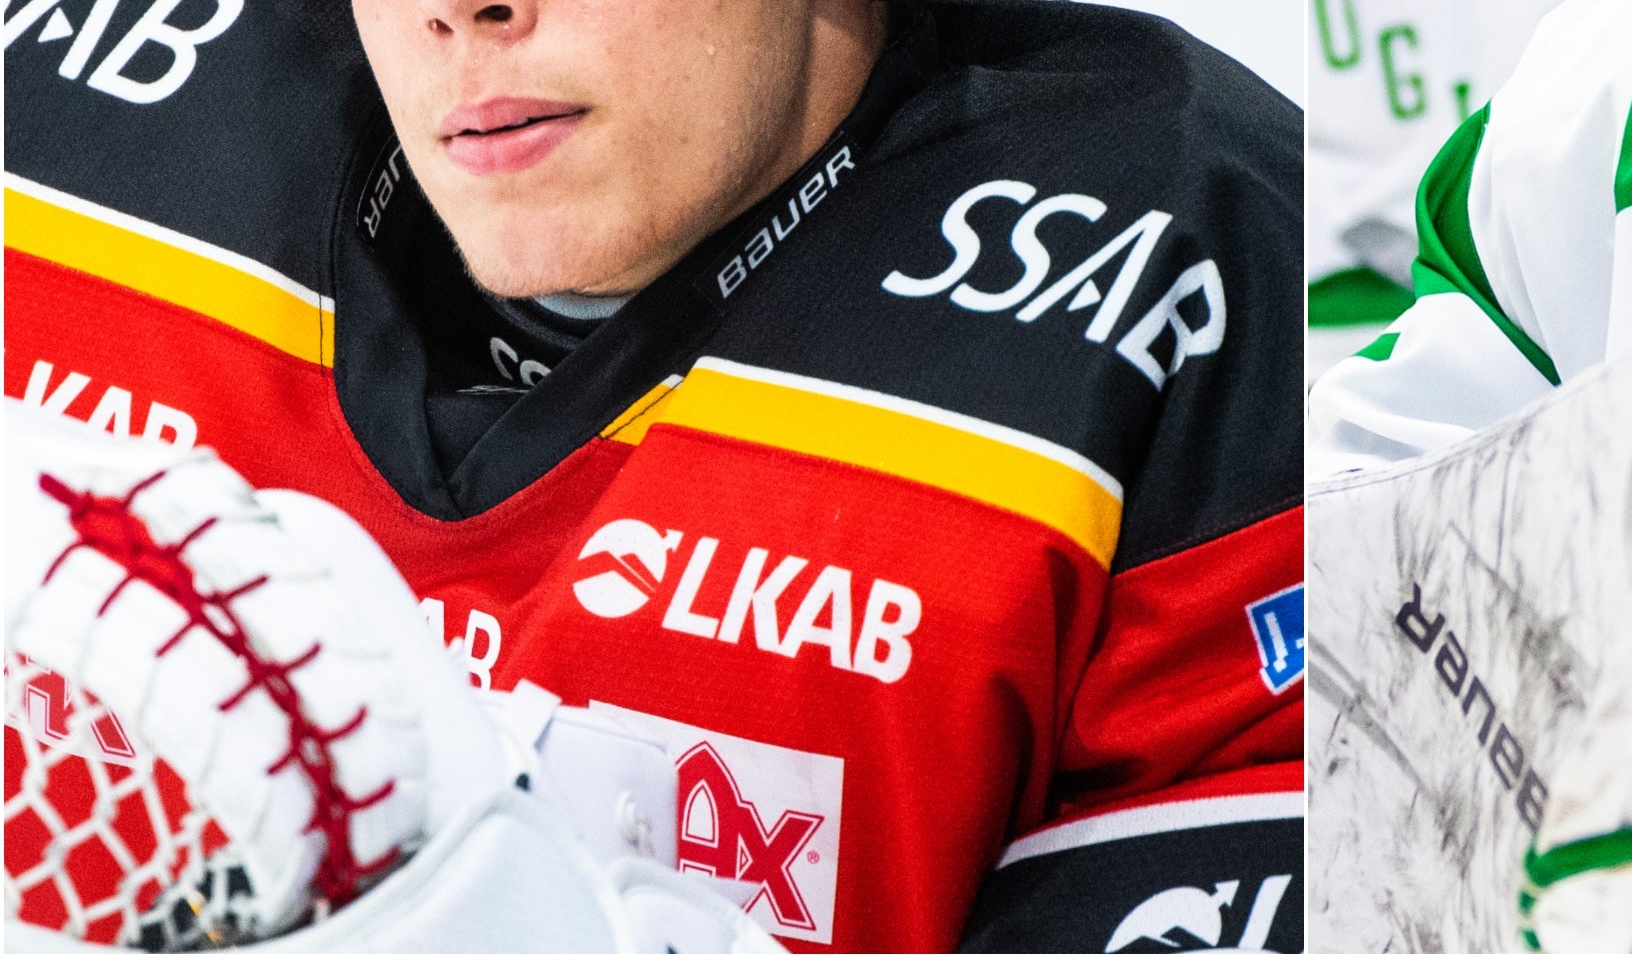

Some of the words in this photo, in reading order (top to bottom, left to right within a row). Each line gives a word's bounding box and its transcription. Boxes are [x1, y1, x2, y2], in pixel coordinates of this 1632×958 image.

[716, 144, 856, 300] BAUER
[881, 179, 1227, 392] SSAB
[661, 537, 923, 684] LKAB
[1396, 581, 1549, 833] BAUER
